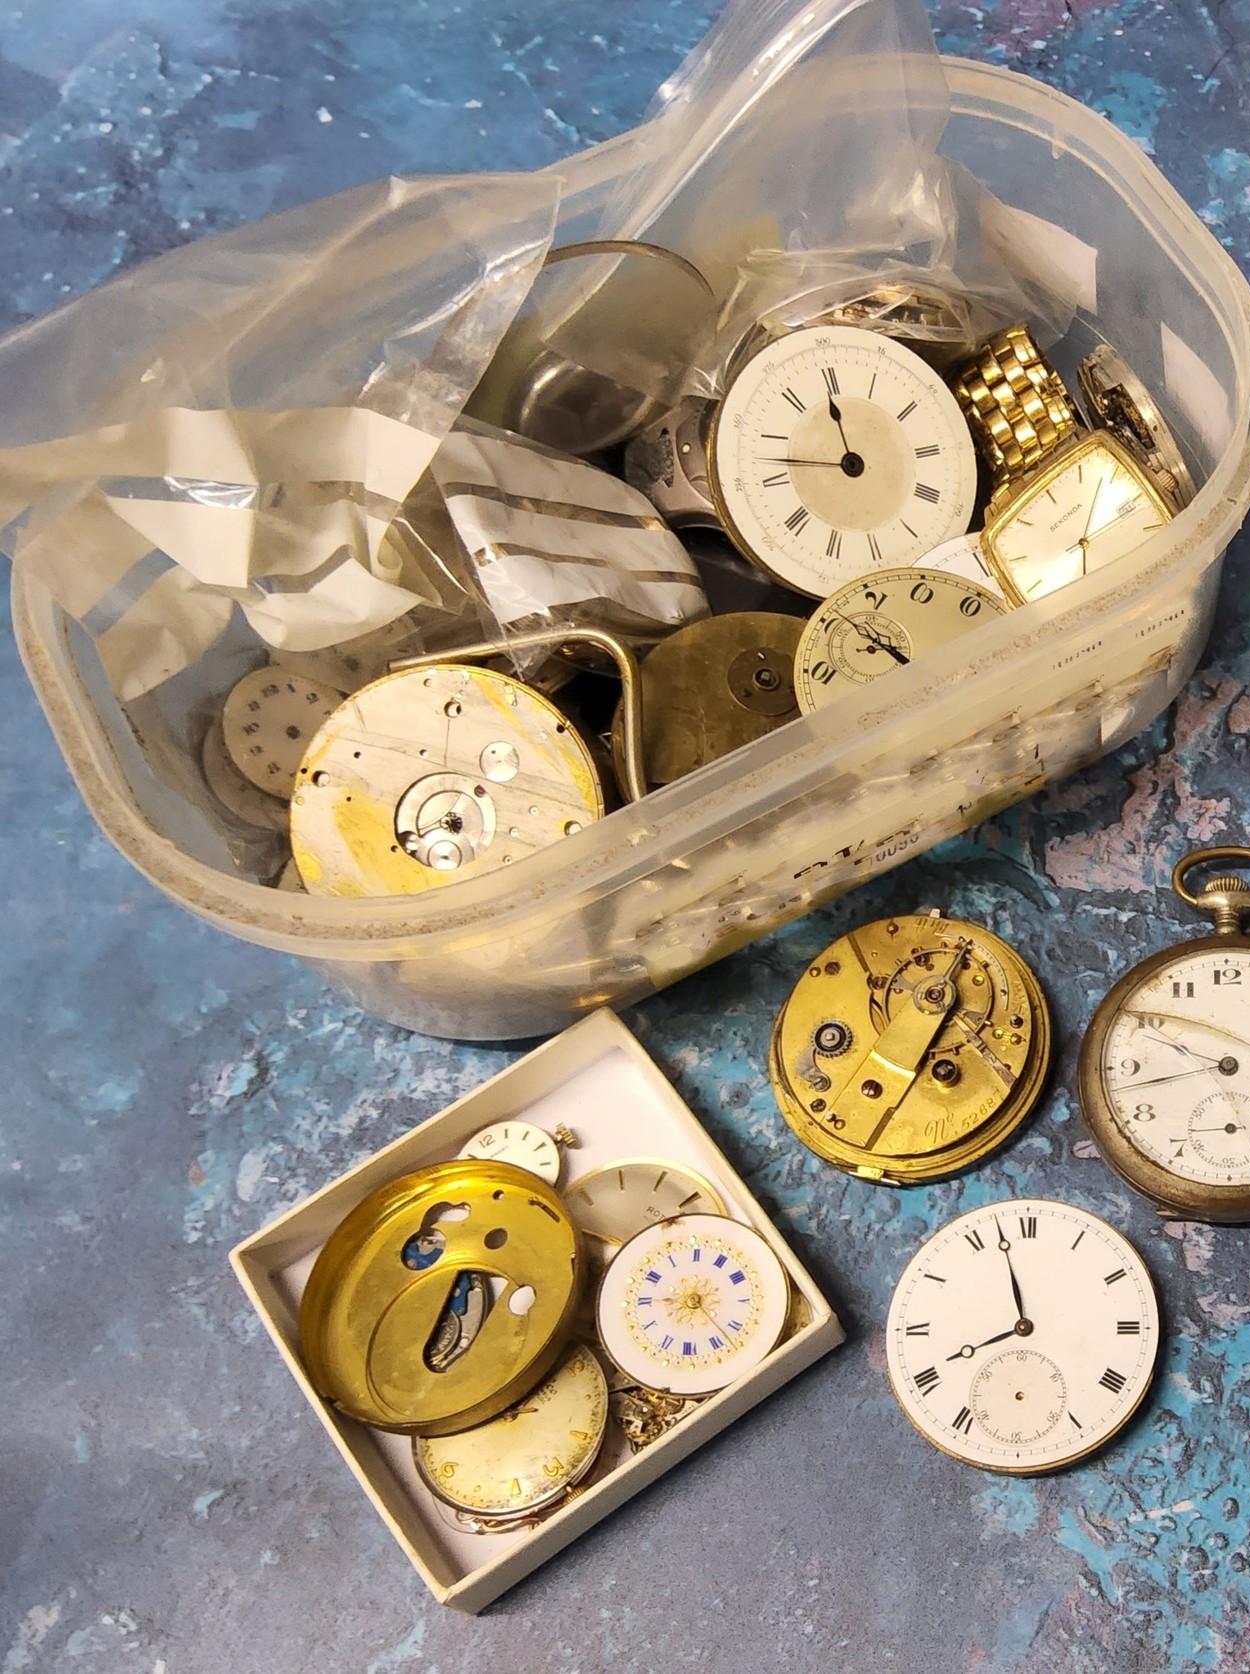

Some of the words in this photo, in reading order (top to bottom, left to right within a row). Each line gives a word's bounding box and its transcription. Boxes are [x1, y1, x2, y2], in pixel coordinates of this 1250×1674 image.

[1049, 503, 1083, 533] SEKONDA
[1213, 968, 1242, 985] 12
[1172, 982, 1195, 998] 11
[1137, 1013, 1165, 1029] 10
[1120, 1058, 1141, 1077] 9
[1132, 1103, 1156, 1122] 8
[478, 1134, 496, 1149] 12
[1169, 1138, 1189, 1158] 7
[646, 1206, 666, 1220] ROT
[440, 1461, 460, 1478] 6
[543, 1456, 565, 1478] 3
